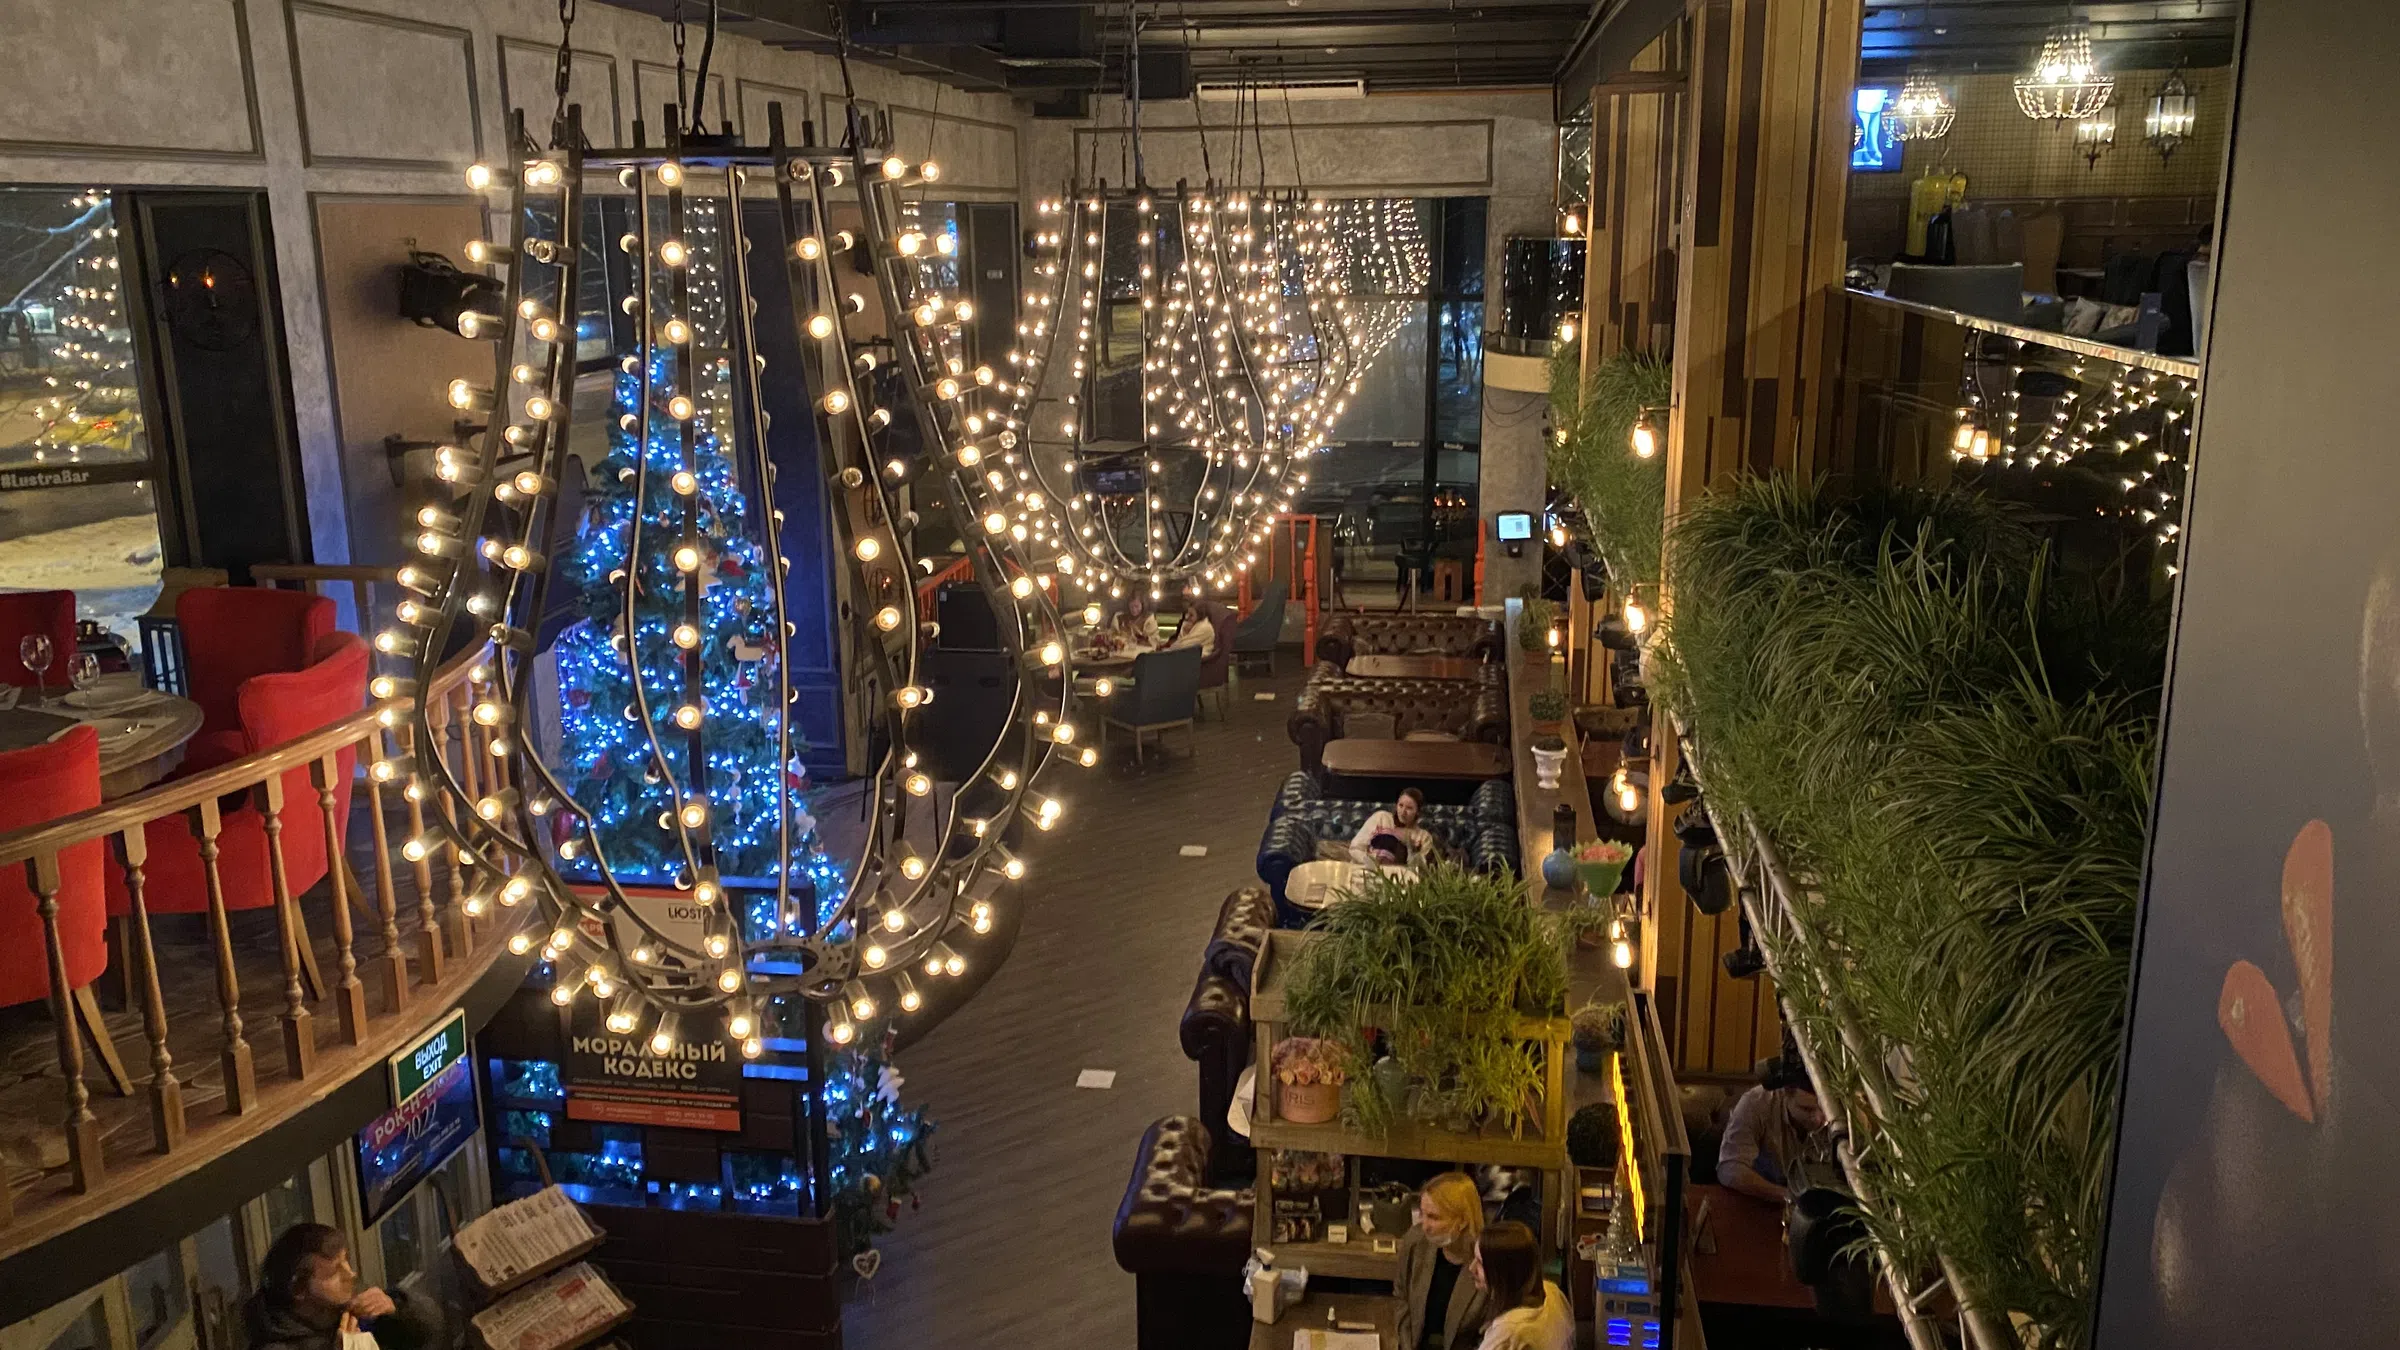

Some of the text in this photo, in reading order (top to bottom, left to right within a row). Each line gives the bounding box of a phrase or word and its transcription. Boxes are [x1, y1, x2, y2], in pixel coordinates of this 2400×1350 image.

[0, 470, 89, 488] #LustraBar
[415, 1031, 448, 1070] ВЫХОД
[572, 1036, 726, 1063] МОРАЛНЫЙ
[423, 1055, 442, 1079] EXIT
[603, 1056, 698, 1080] КОДЕКС
[402, 1099, 440, 1153] 2022
